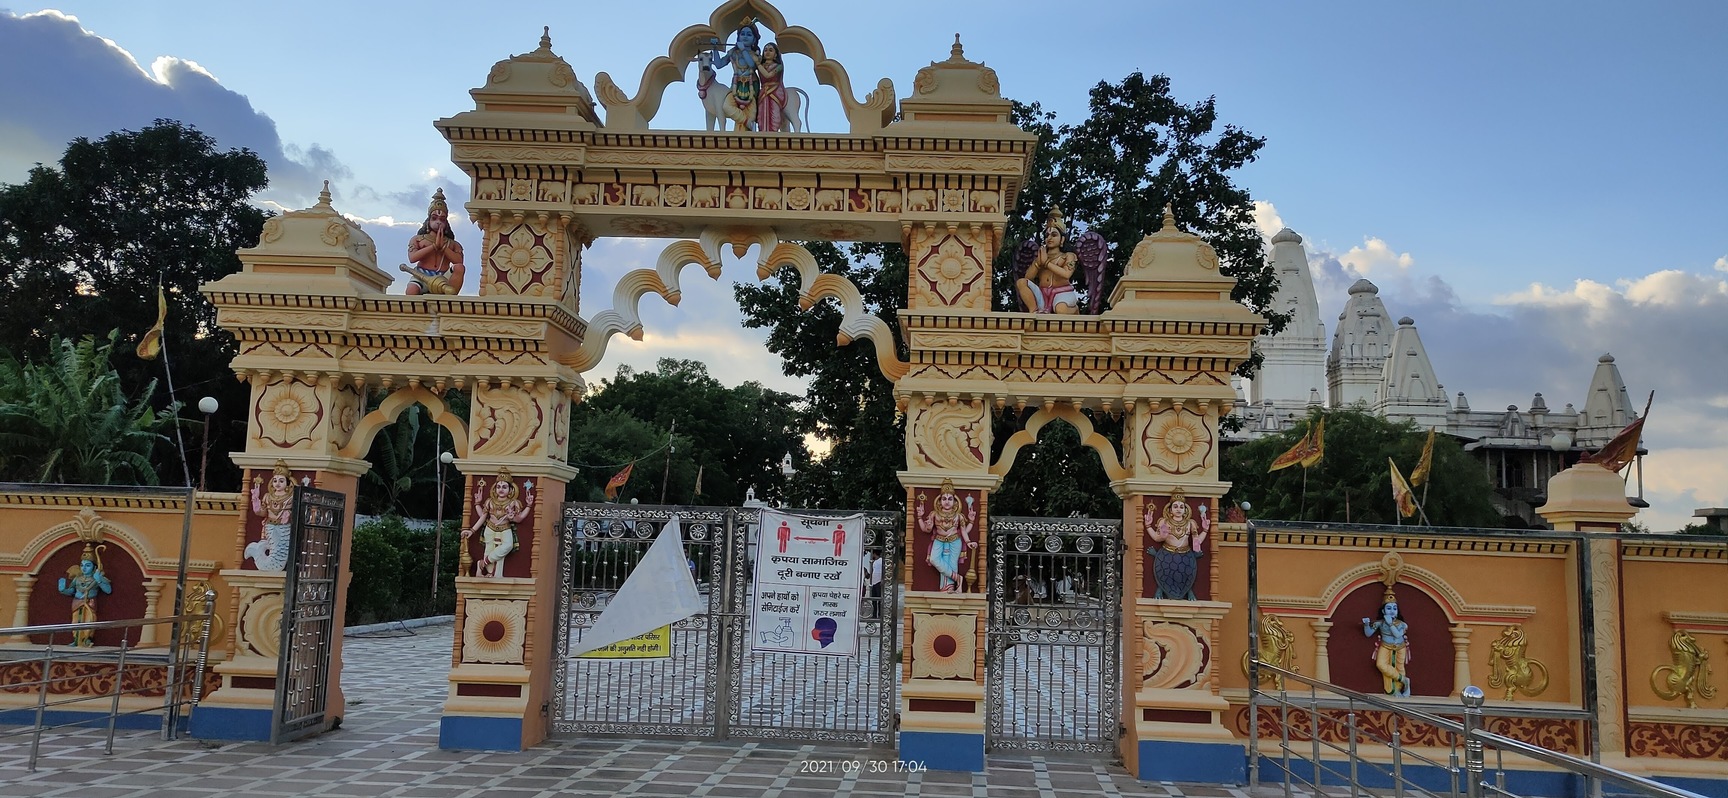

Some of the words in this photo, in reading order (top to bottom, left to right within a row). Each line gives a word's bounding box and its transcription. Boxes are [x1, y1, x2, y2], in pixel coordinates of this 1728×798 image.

[800, 519, 829, 529] सूचना
[771, 555, 799, 565] कृपया
[802, 556, 848, 567] सामाजिक
[777, 568, 793, 580] दूरी
[795, 571, 820, 580] बनाए
[761, 590, 776, 599] अपने
[791, 592, 799, 601] को
[812, 591, 828, 599] कृपया
[789, 604, 800, 613] करें
